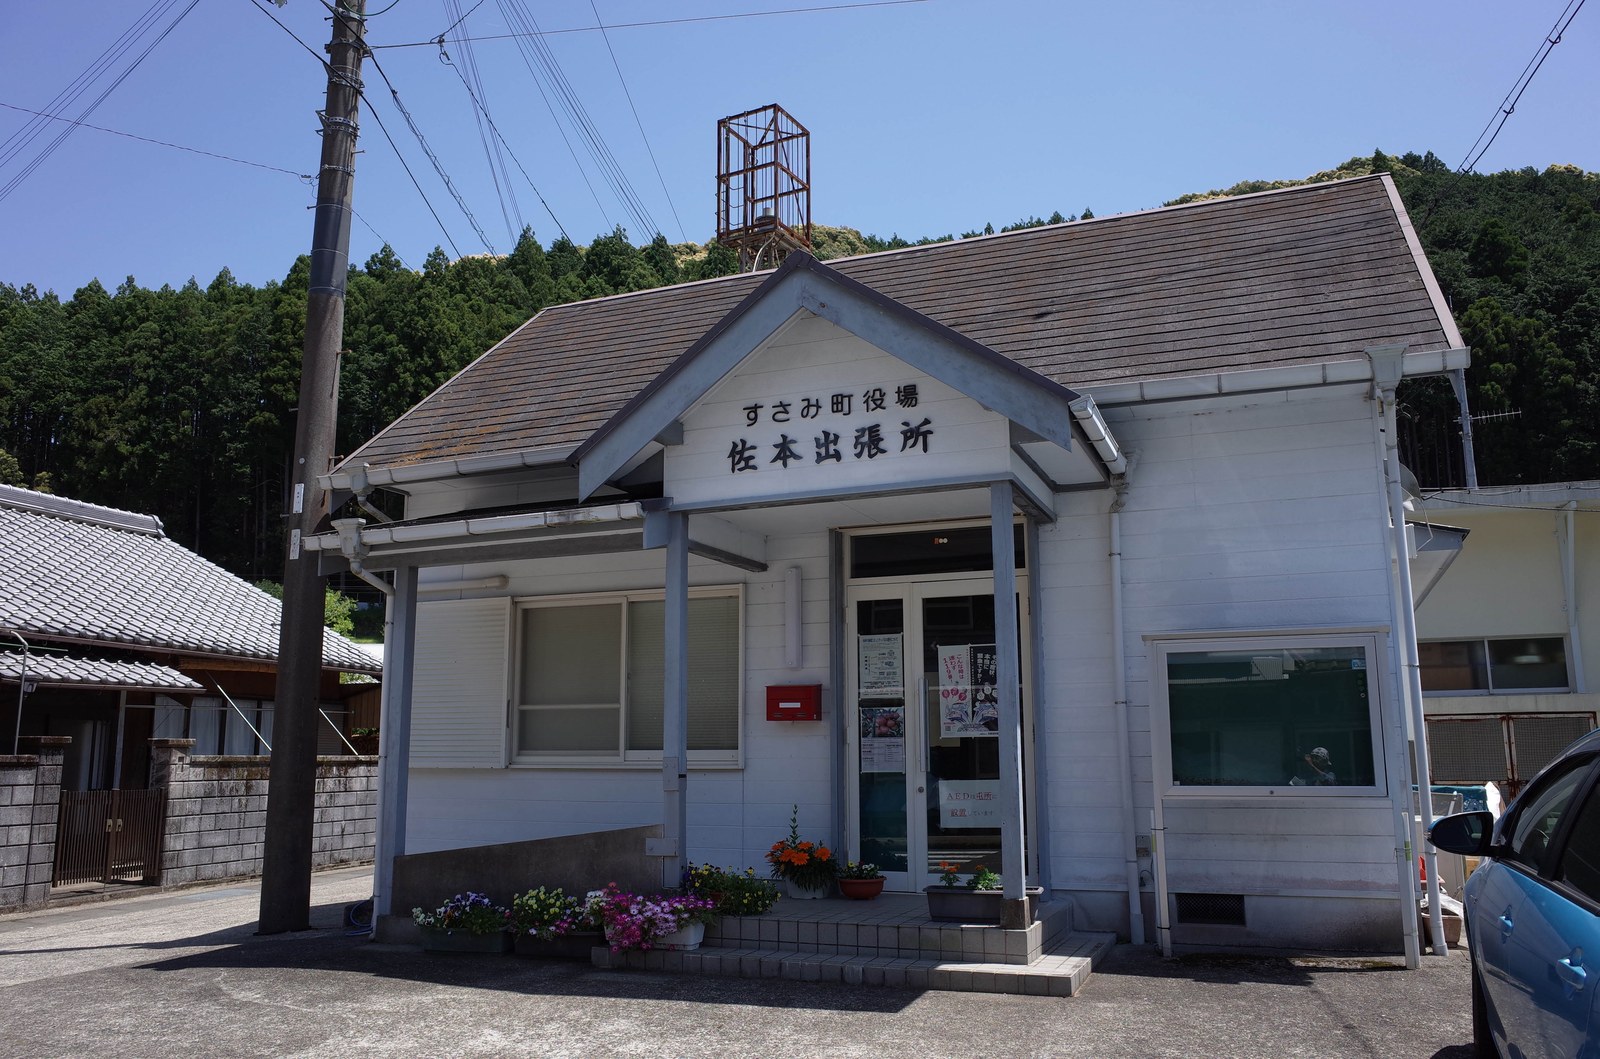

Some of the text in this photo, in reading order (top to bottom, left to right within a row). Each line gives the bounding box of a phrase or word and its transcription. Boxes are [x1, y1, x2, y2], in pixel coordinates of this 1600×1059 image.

[743, 384, 919, 427] すさみ町役場
[727, 418, 934, 473] 佐本出張所
